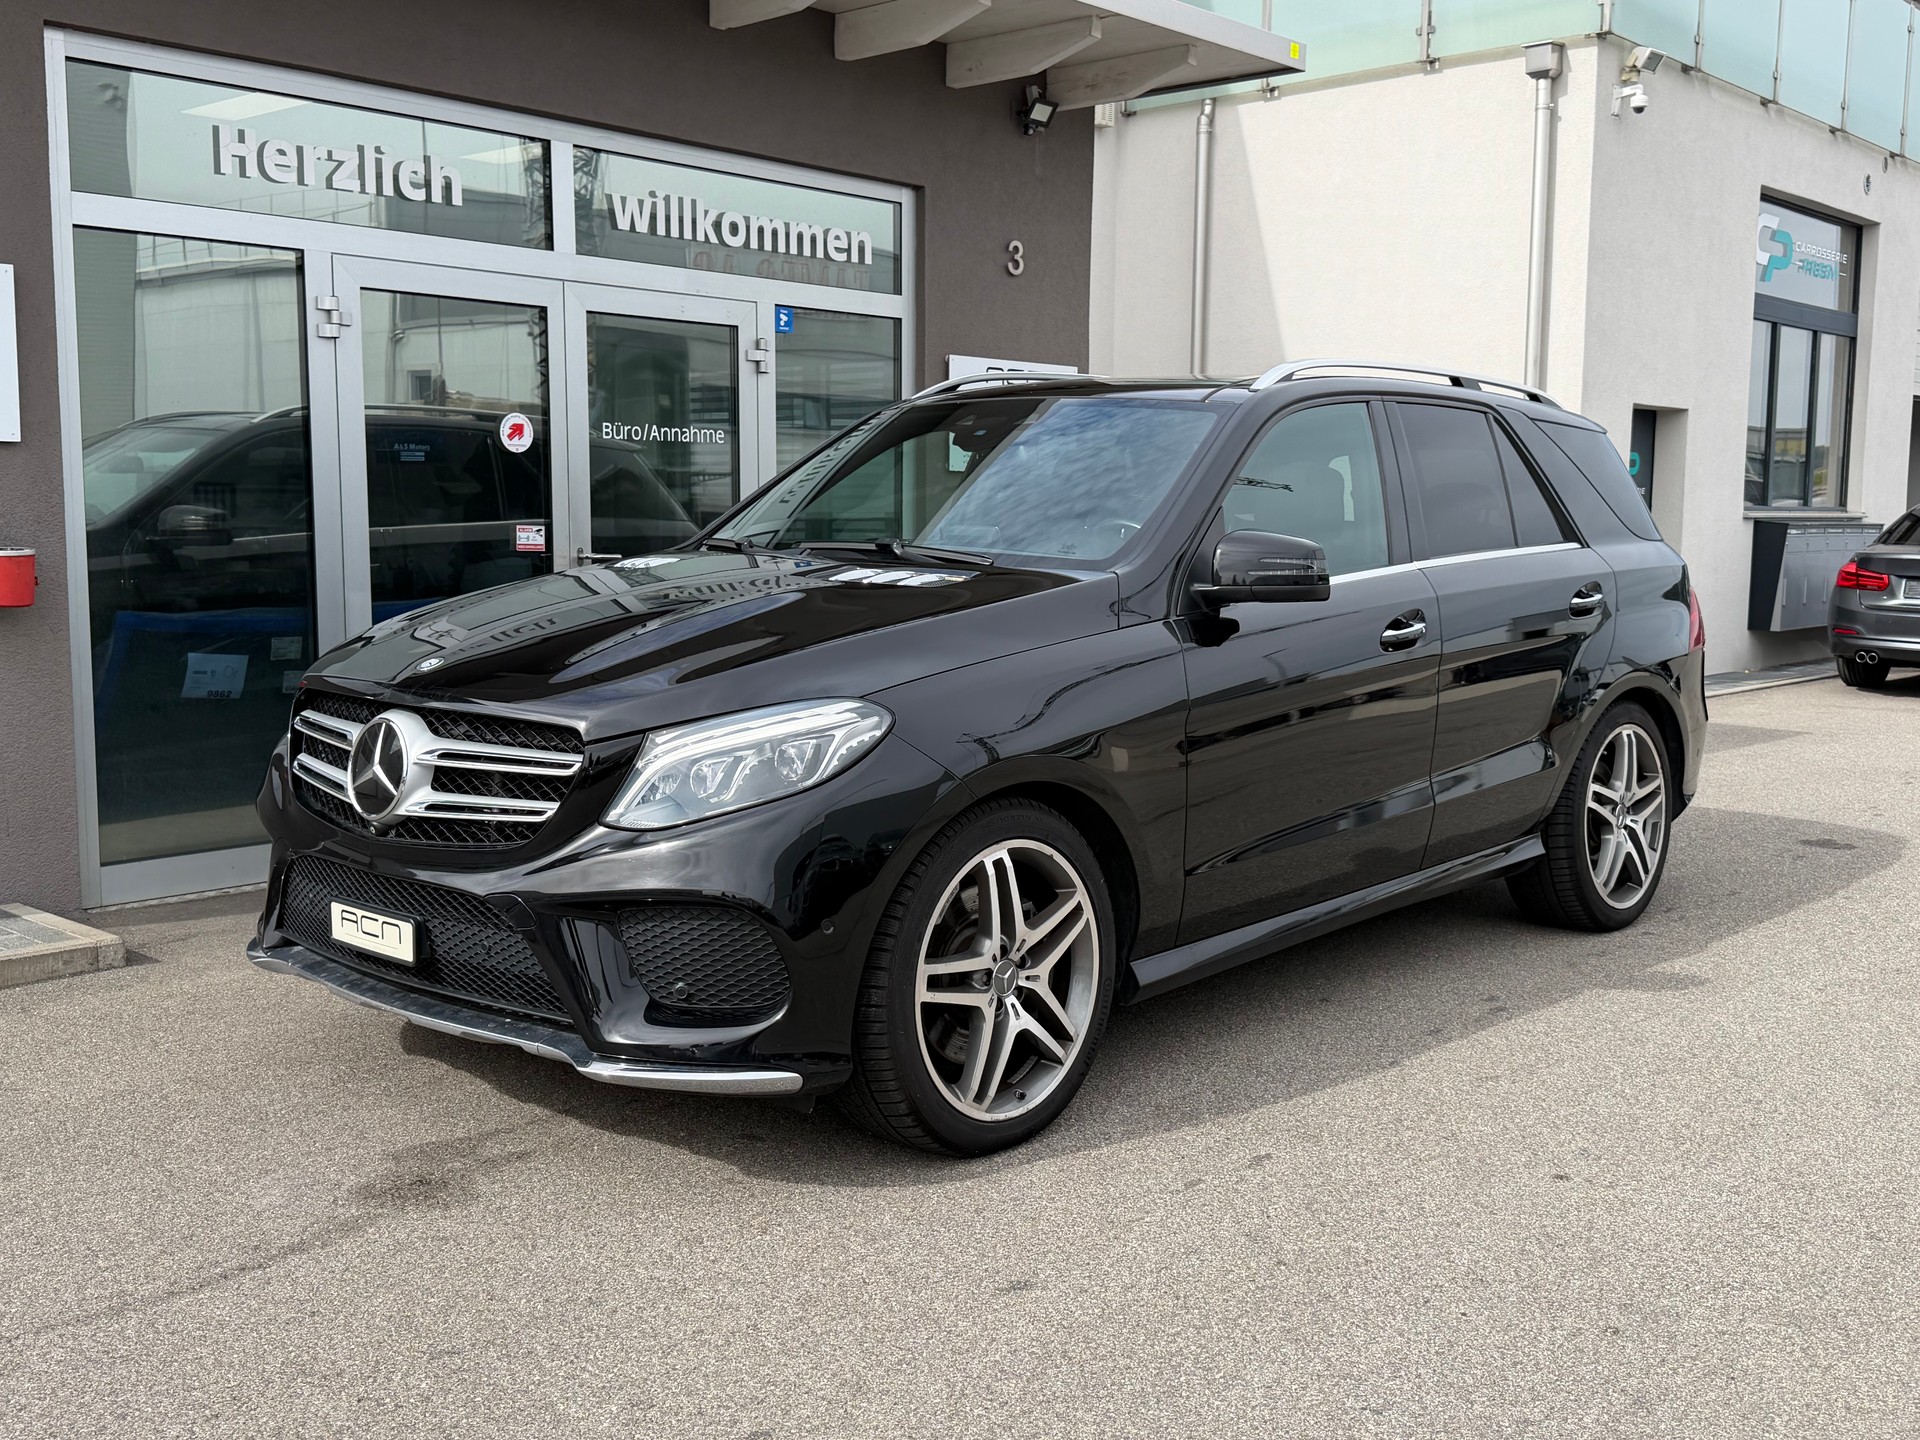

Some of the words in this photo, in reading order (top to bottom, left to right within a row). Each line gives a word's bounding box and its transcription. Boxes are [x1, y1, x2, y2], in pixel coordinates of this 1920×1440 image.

[217, 124, 463, 207] Herzlich
[610, 190, 873, 265] willkommen
[1008, 240, 1024, 276] 3
[1795, 241, 1848, 264] CARROSSERIE
[602, 421, 725, 444] Büro/Annahme
